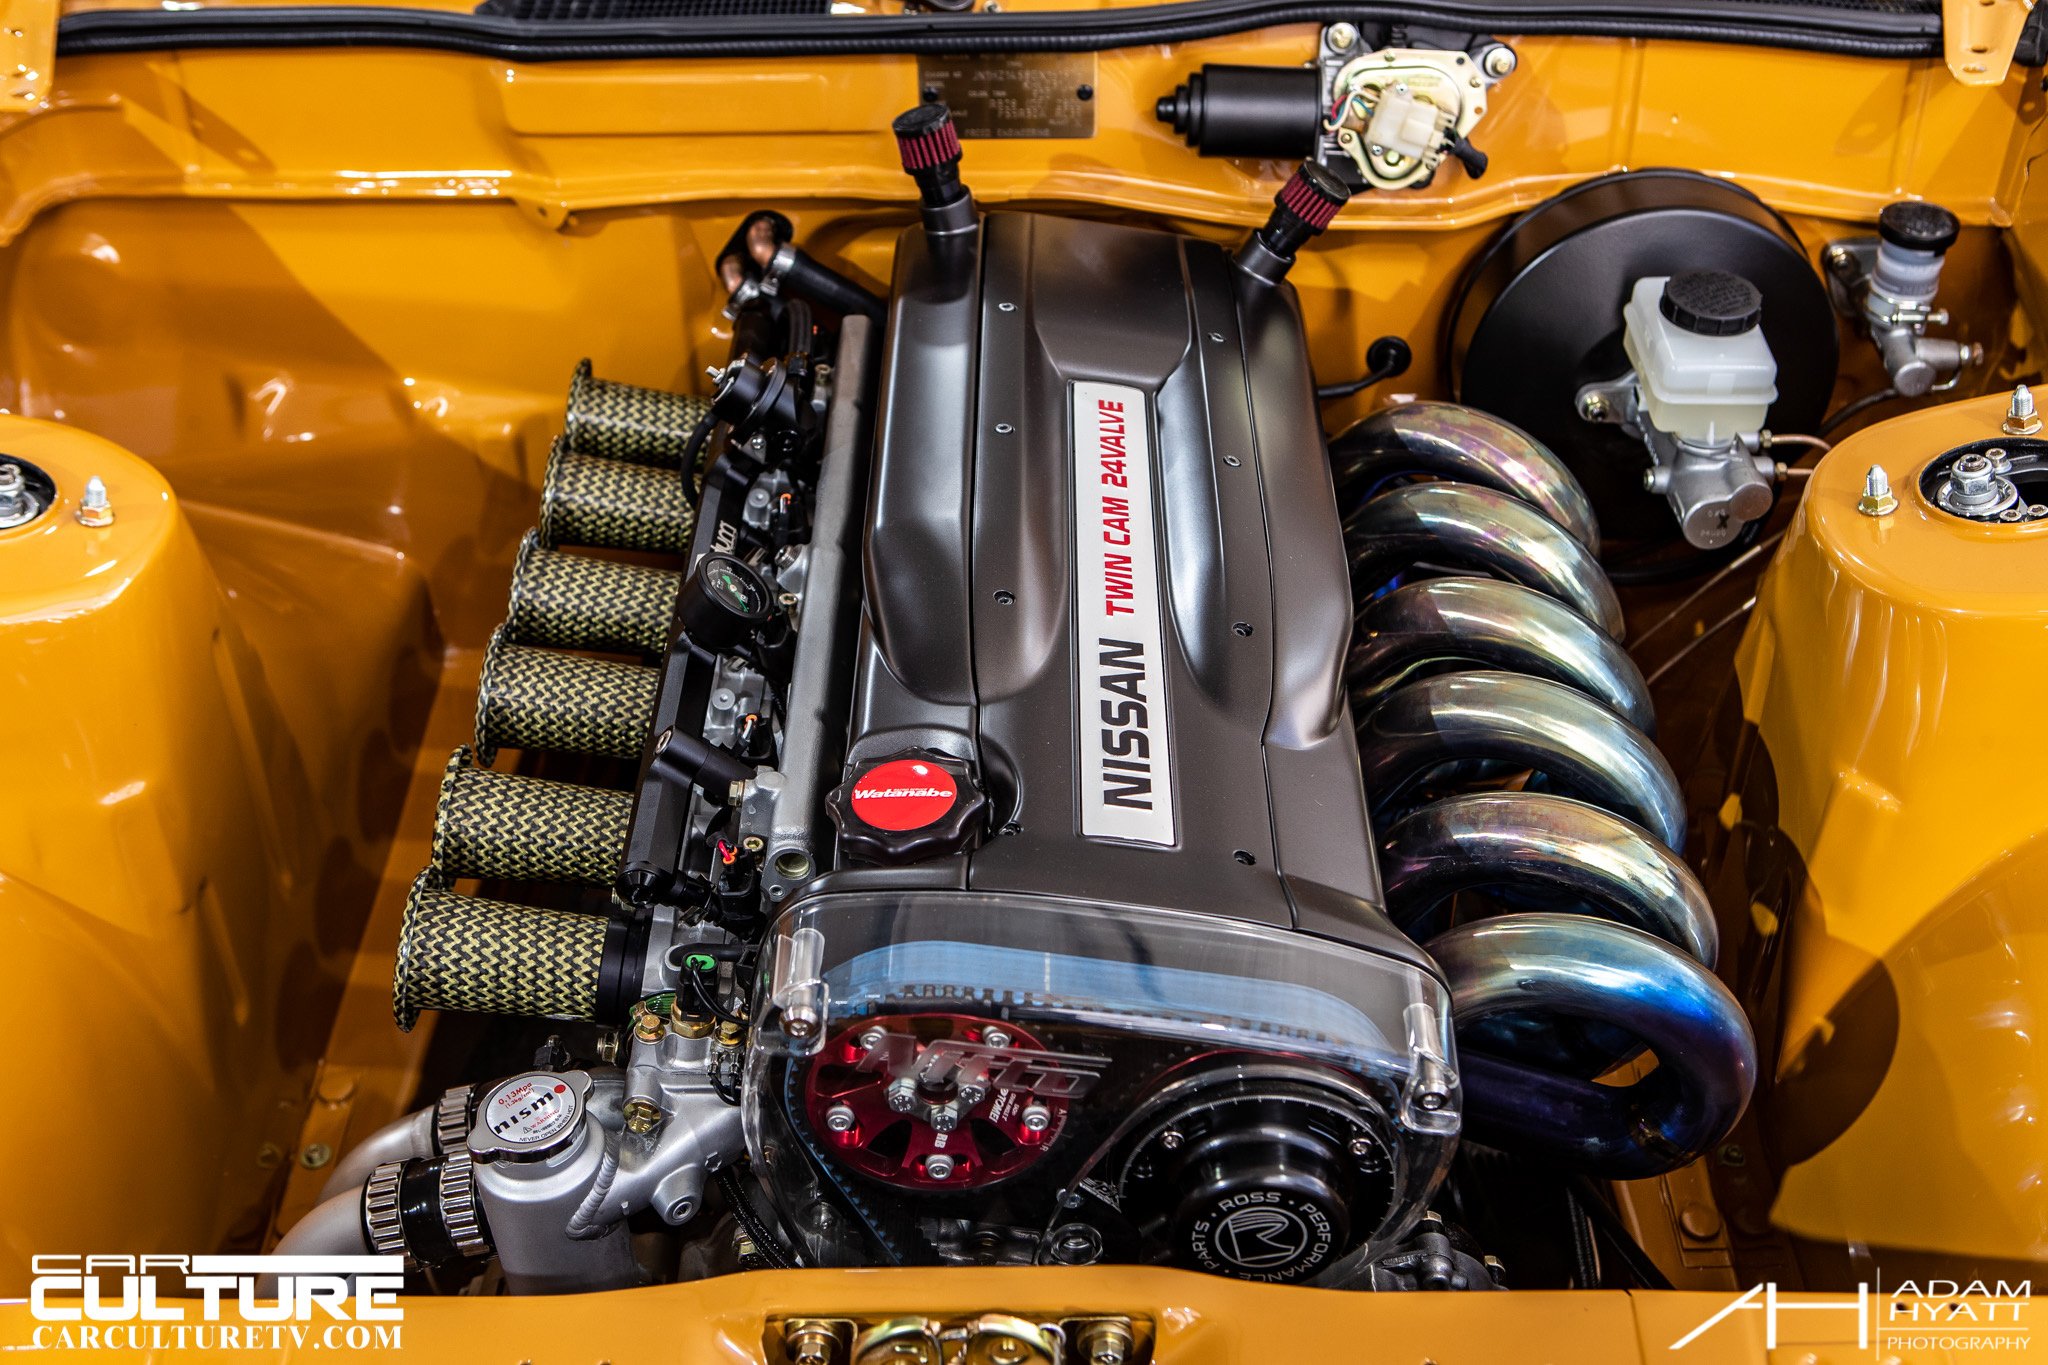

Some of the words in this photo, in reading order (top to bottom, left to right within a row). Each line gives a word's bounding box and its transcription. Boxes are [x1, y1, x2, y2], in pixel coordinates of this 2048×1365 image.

[1098, 400, 1128, 488] 24VALVE
[1102, 499, 1130, 546] CAM
[1104, 552, 1133, 616] TWIN
[1098, 638, 1152, 811] NISSAN
[855, 788, 952, 800] Watanabe
[498, 1082, 532, 1105] 0.13Mpa
[530, 1109, 560, 1129] WARNING
[541, 1127, 557, 1138] OPEN
[557, 1114, 570, 1130] WHEN
[934, 1132, 949, 1149] RB
[1218, 1191, 1282, 1212] ROSS
[1191, 1220, 1220, 1270] PARTS
